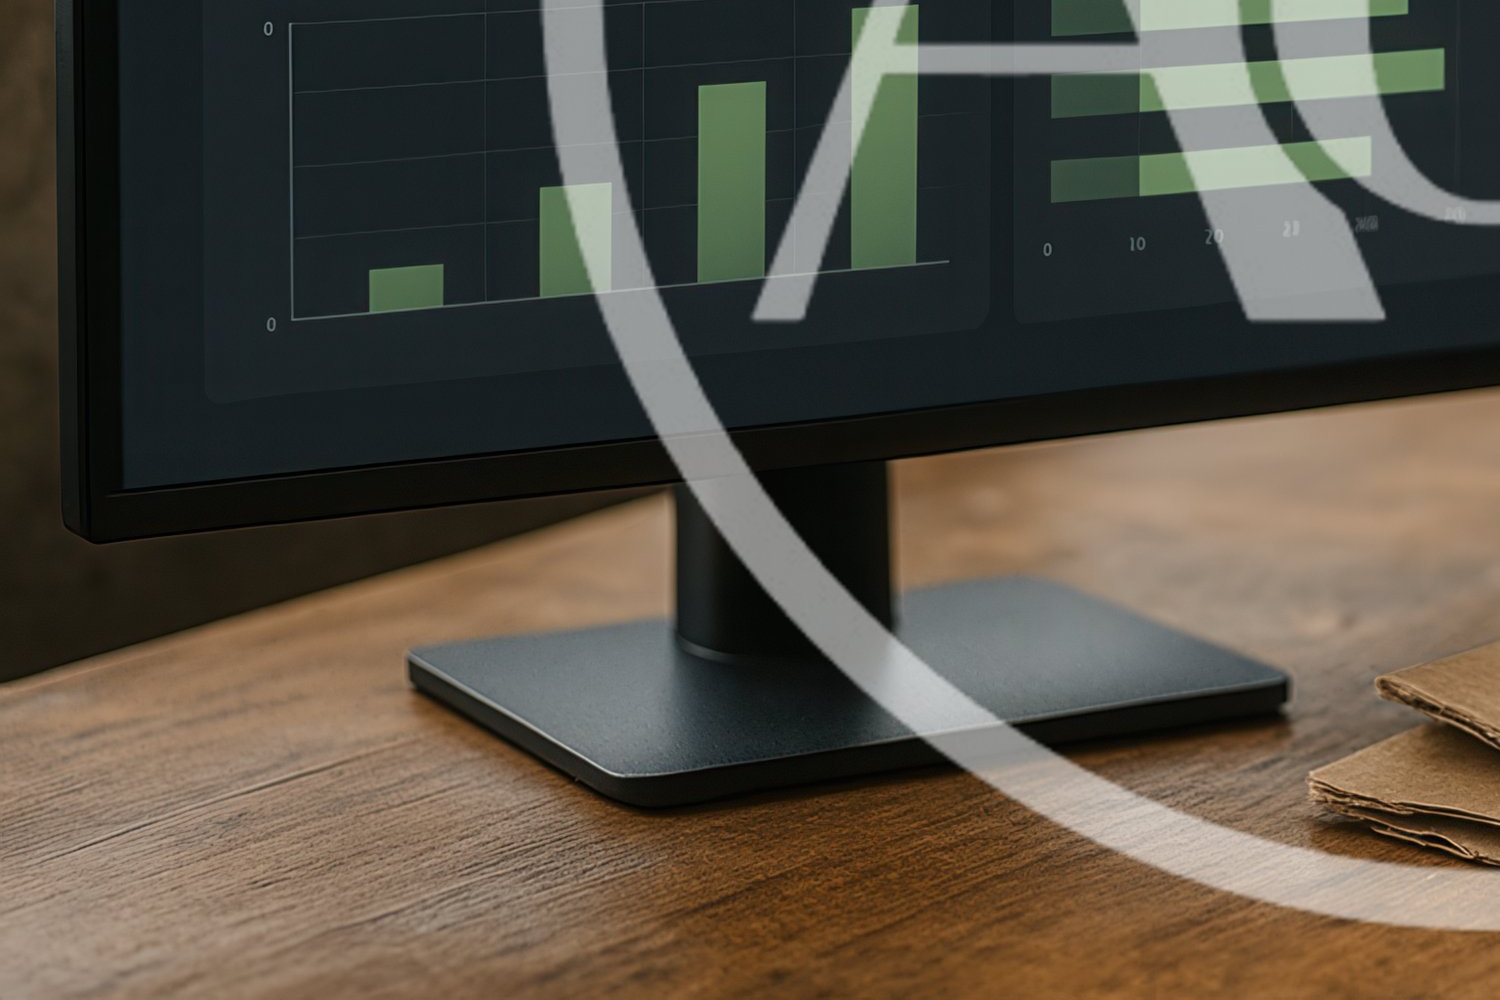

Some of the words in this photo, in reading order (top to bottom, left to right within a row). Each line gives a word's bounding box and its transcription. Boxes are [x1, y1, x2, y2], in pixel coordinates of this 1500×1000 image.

[263, 21, 274, 38] 0
[1042, 242, 1053, 257] 0
[1129, 236, 1147, 252] 10
[1204, 228, 1225, 245] 20
[266, 316, 277, 333] 0
